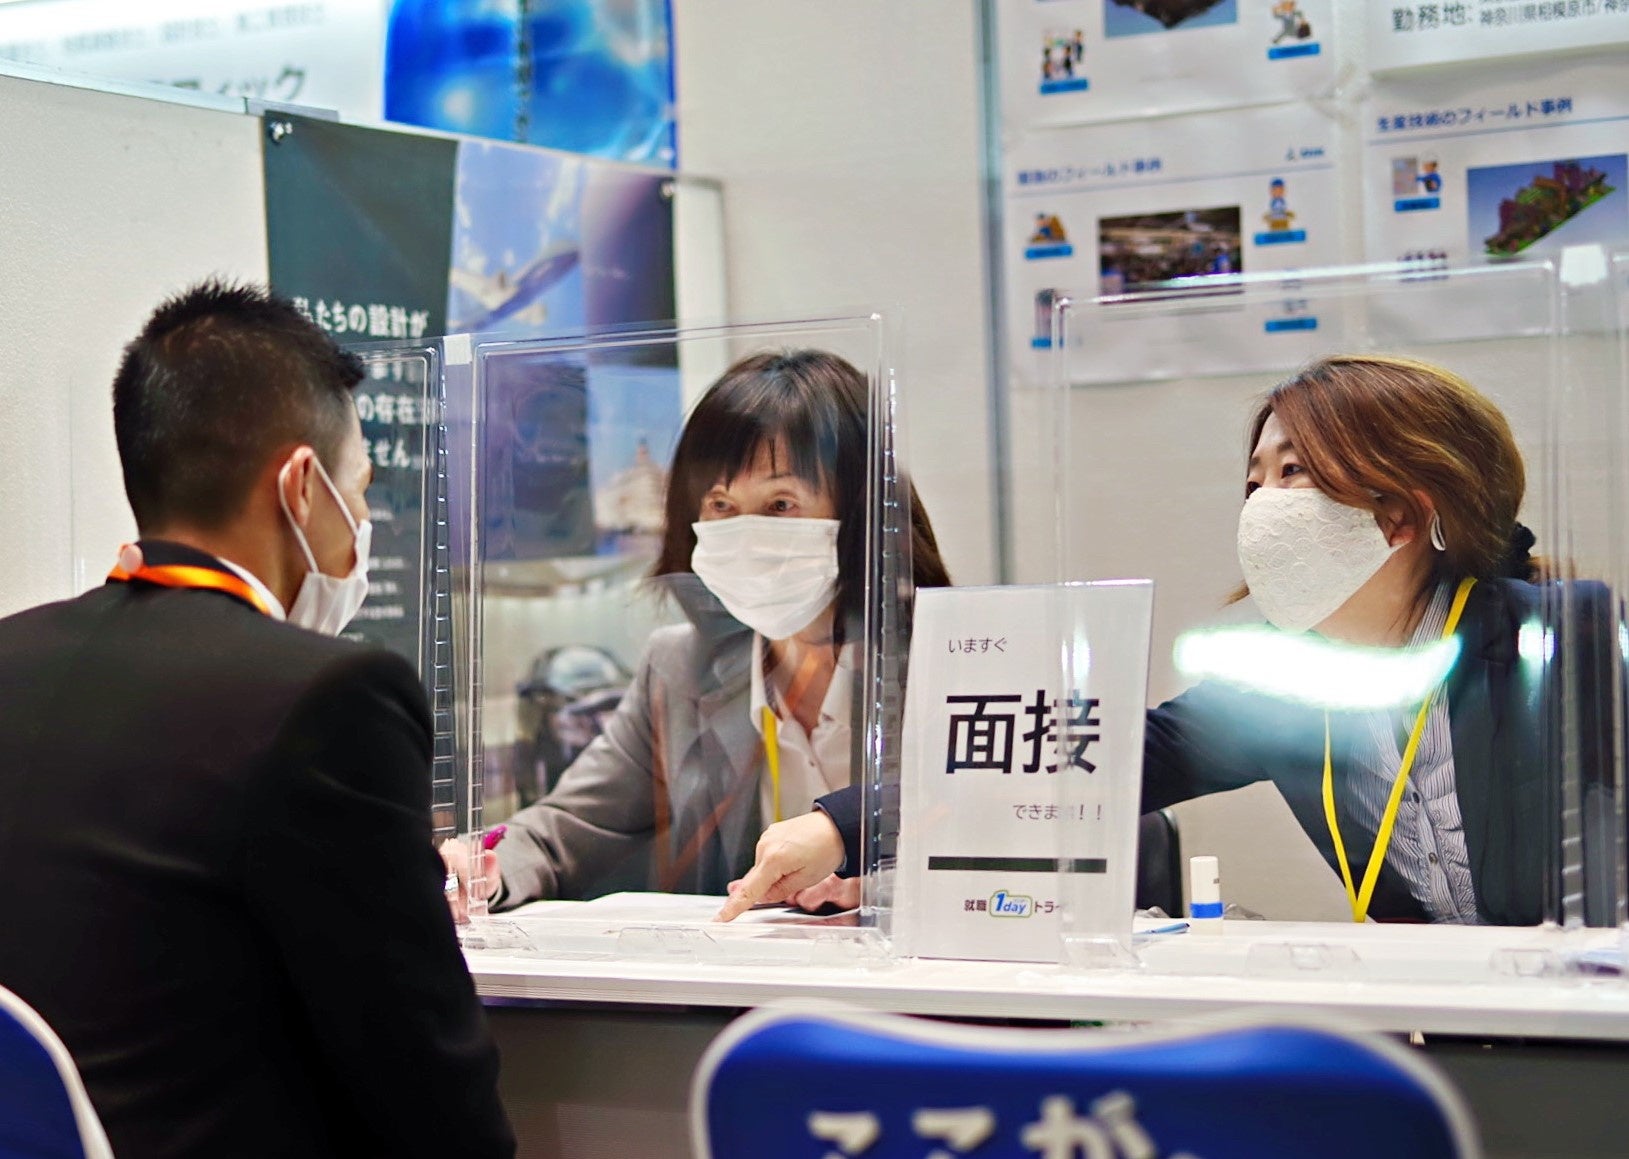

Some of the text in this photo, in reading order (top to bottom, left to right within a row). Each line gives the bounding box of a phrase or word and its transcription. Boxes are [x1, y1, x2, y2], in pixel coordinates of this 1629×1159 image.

[948, 637, 1008, 653] いますぐ
[945, 689, 1100, 774] 面接
[964, 899, 987, 912] 就職
[995, 892, 1026, 915] 1day
